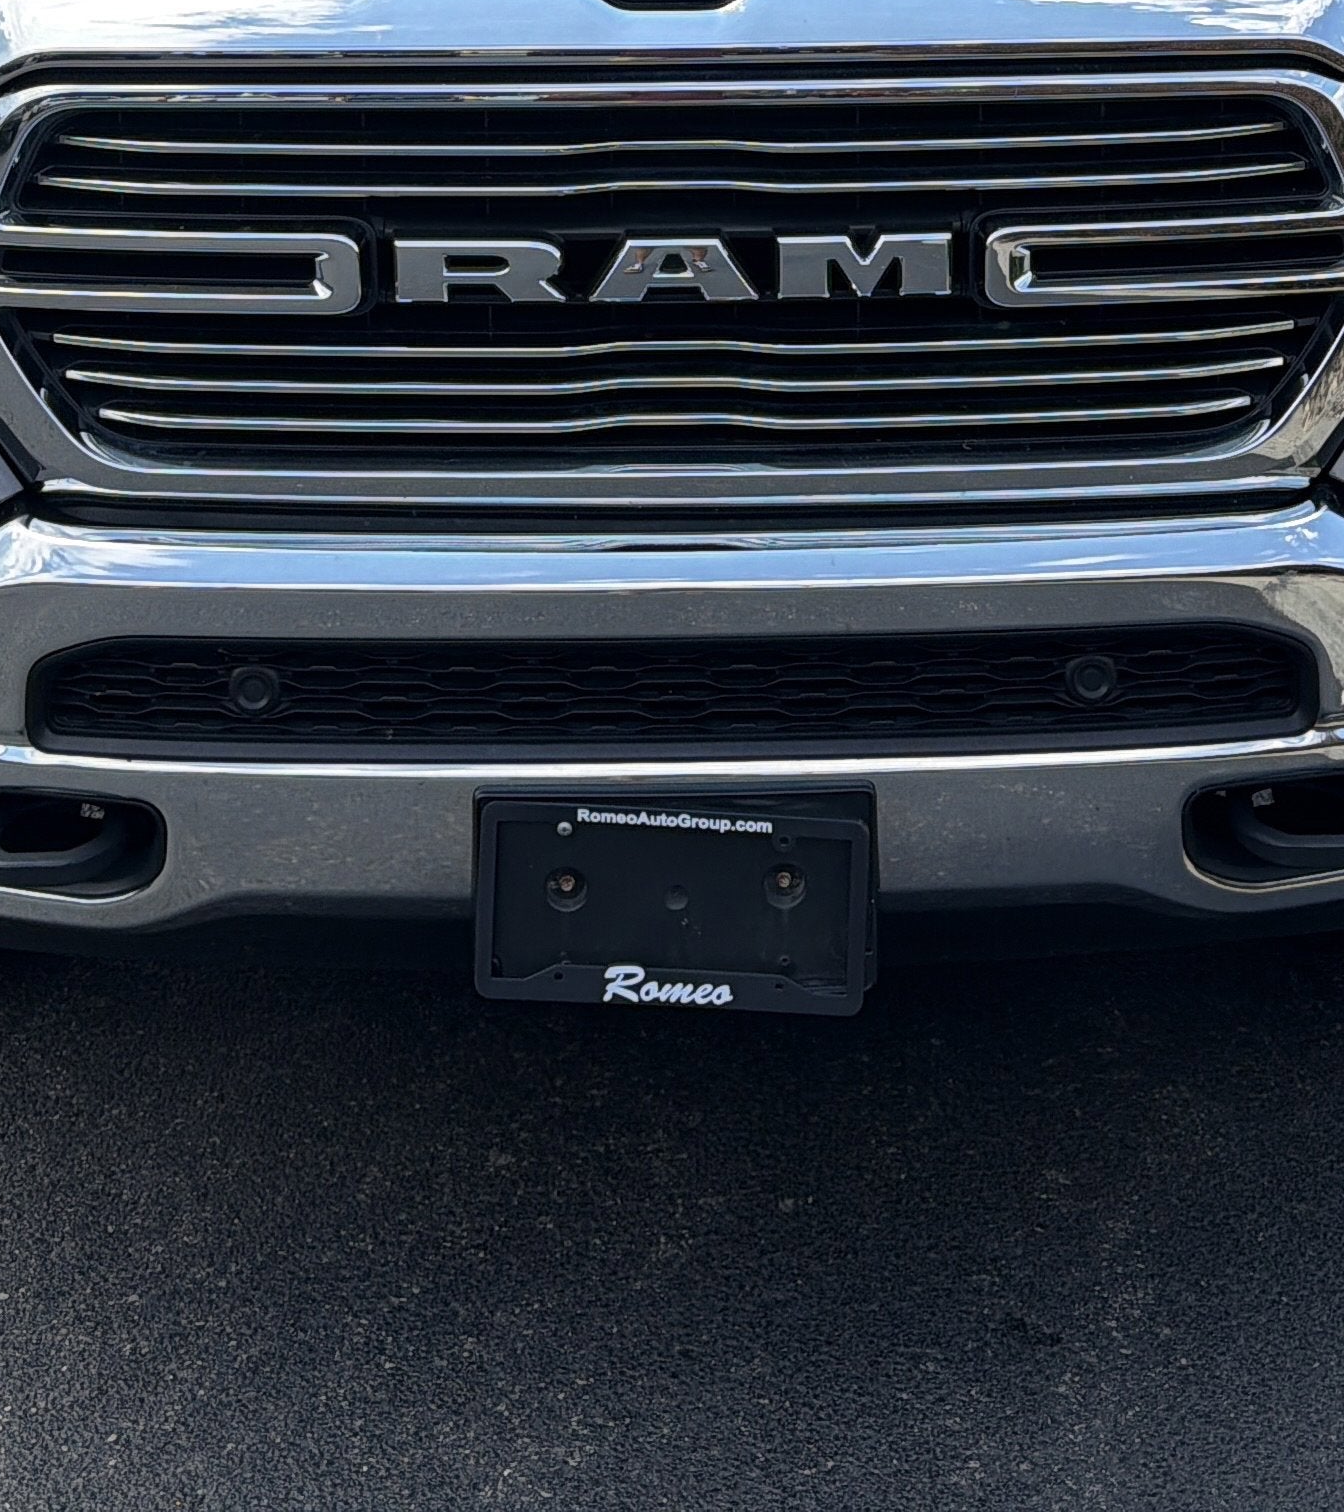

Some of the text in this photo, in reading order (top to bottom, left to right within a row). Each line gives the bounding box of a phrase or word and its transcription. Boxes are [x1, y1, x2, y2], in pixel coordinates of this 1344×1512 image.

[394, 232, 952, 303] RAM
[576, 808, 773, 834] RomeoAutoGroup.com
[602, 965, 734, 1006] Romeo
